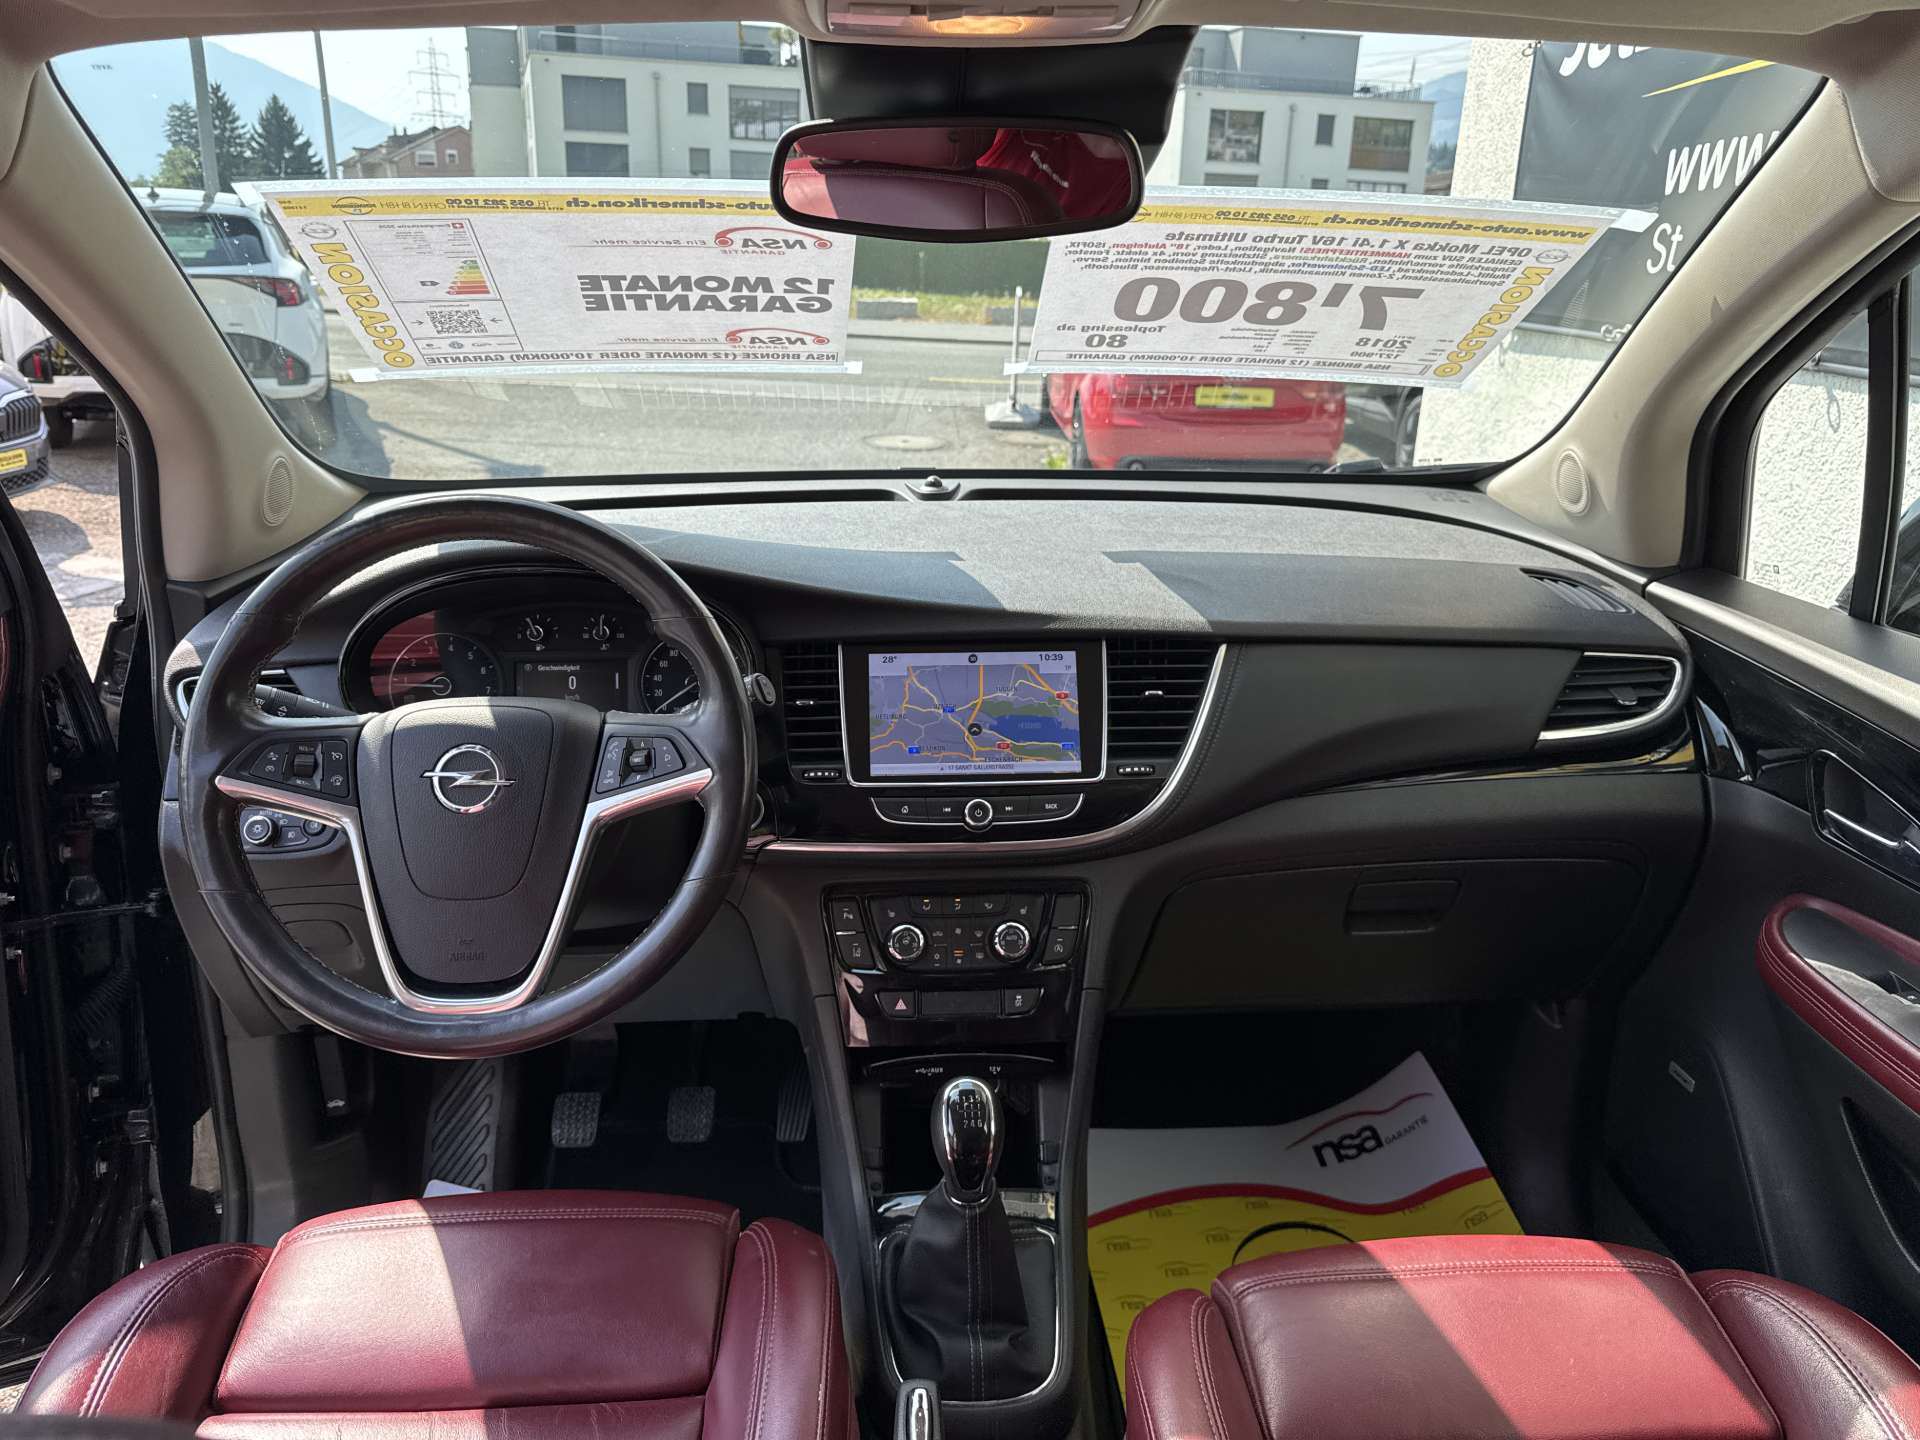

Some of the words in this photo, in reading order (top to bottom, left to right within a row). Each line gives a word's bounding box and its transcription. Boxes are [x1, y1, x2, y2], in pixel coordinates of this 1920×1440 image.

[1646, 222, 1684, 274] St
[1039, 653, 1064, 661] 10:39
[568, 675, 577, 690] 0
[1312, 1124, 1385, 1168] nsa
[1383, 1114, 1429, 1146] GARANTIE
